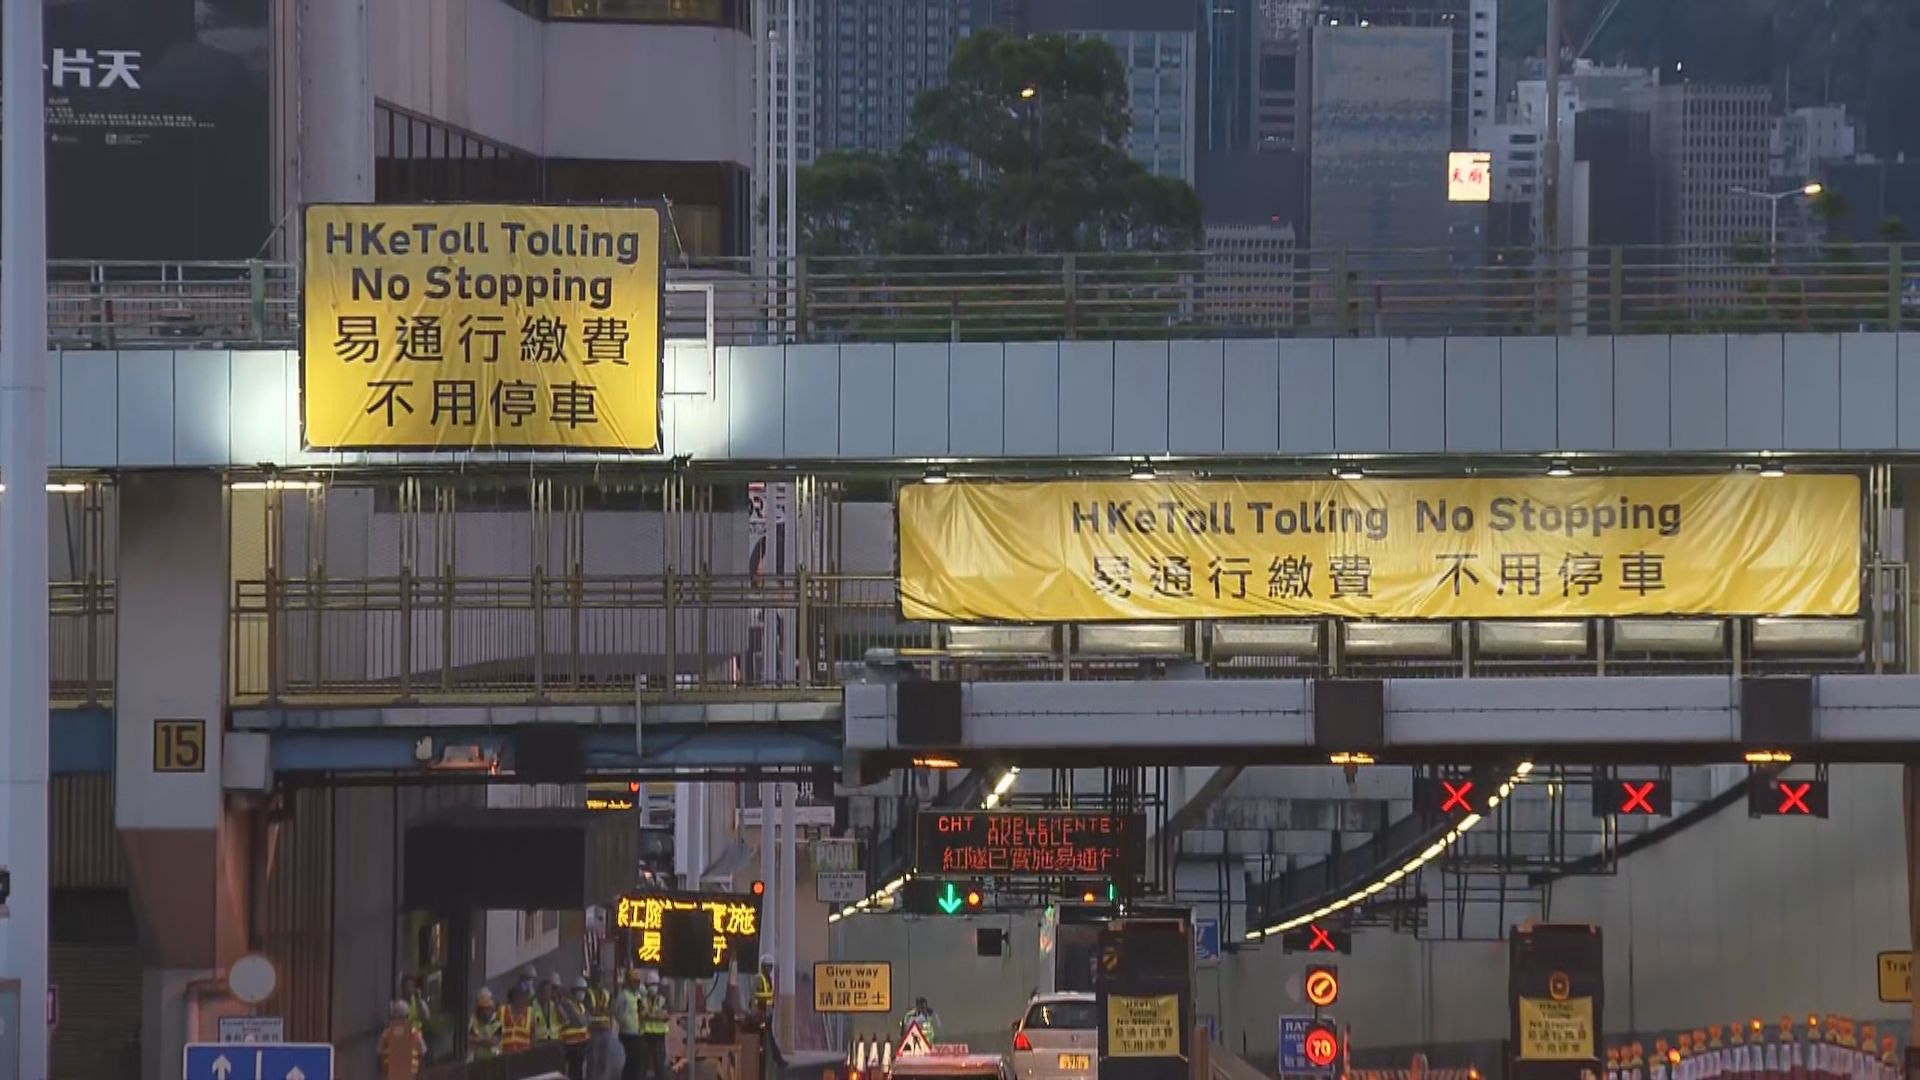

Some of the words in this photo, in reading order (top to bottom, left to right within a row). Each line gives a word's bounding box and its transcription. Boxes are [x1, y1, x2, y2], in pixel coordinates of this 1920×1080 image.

[42, 48, 141, 89] 片天
[326, 222, 489, 255] HKeToll
[501, 222, 639, 264] Tolling
[352, 267, 410, 301] No
[424, 266, 612, 309] Stopping
[334, 315, 630, 366] 易通行繳費
[366, 380, 598, 429] 不用停車
[1072, 500, 1235, 535] HKeToll
[1247, 500, 1389, 541] Tolling
[1416, 499, 1474, 532] No
[1488, 496, 1682, 537] Stopping
[161, 725, 199, 767] 15
[938, 816, 973, 832] CHT
[826, 966, 851, 977] Give
[855, 967, 879, 979] way
[834, 978, 846, 989] to
[850, 978, 871, 989] bus
[1312, 1039, 1331, 1057] 70
